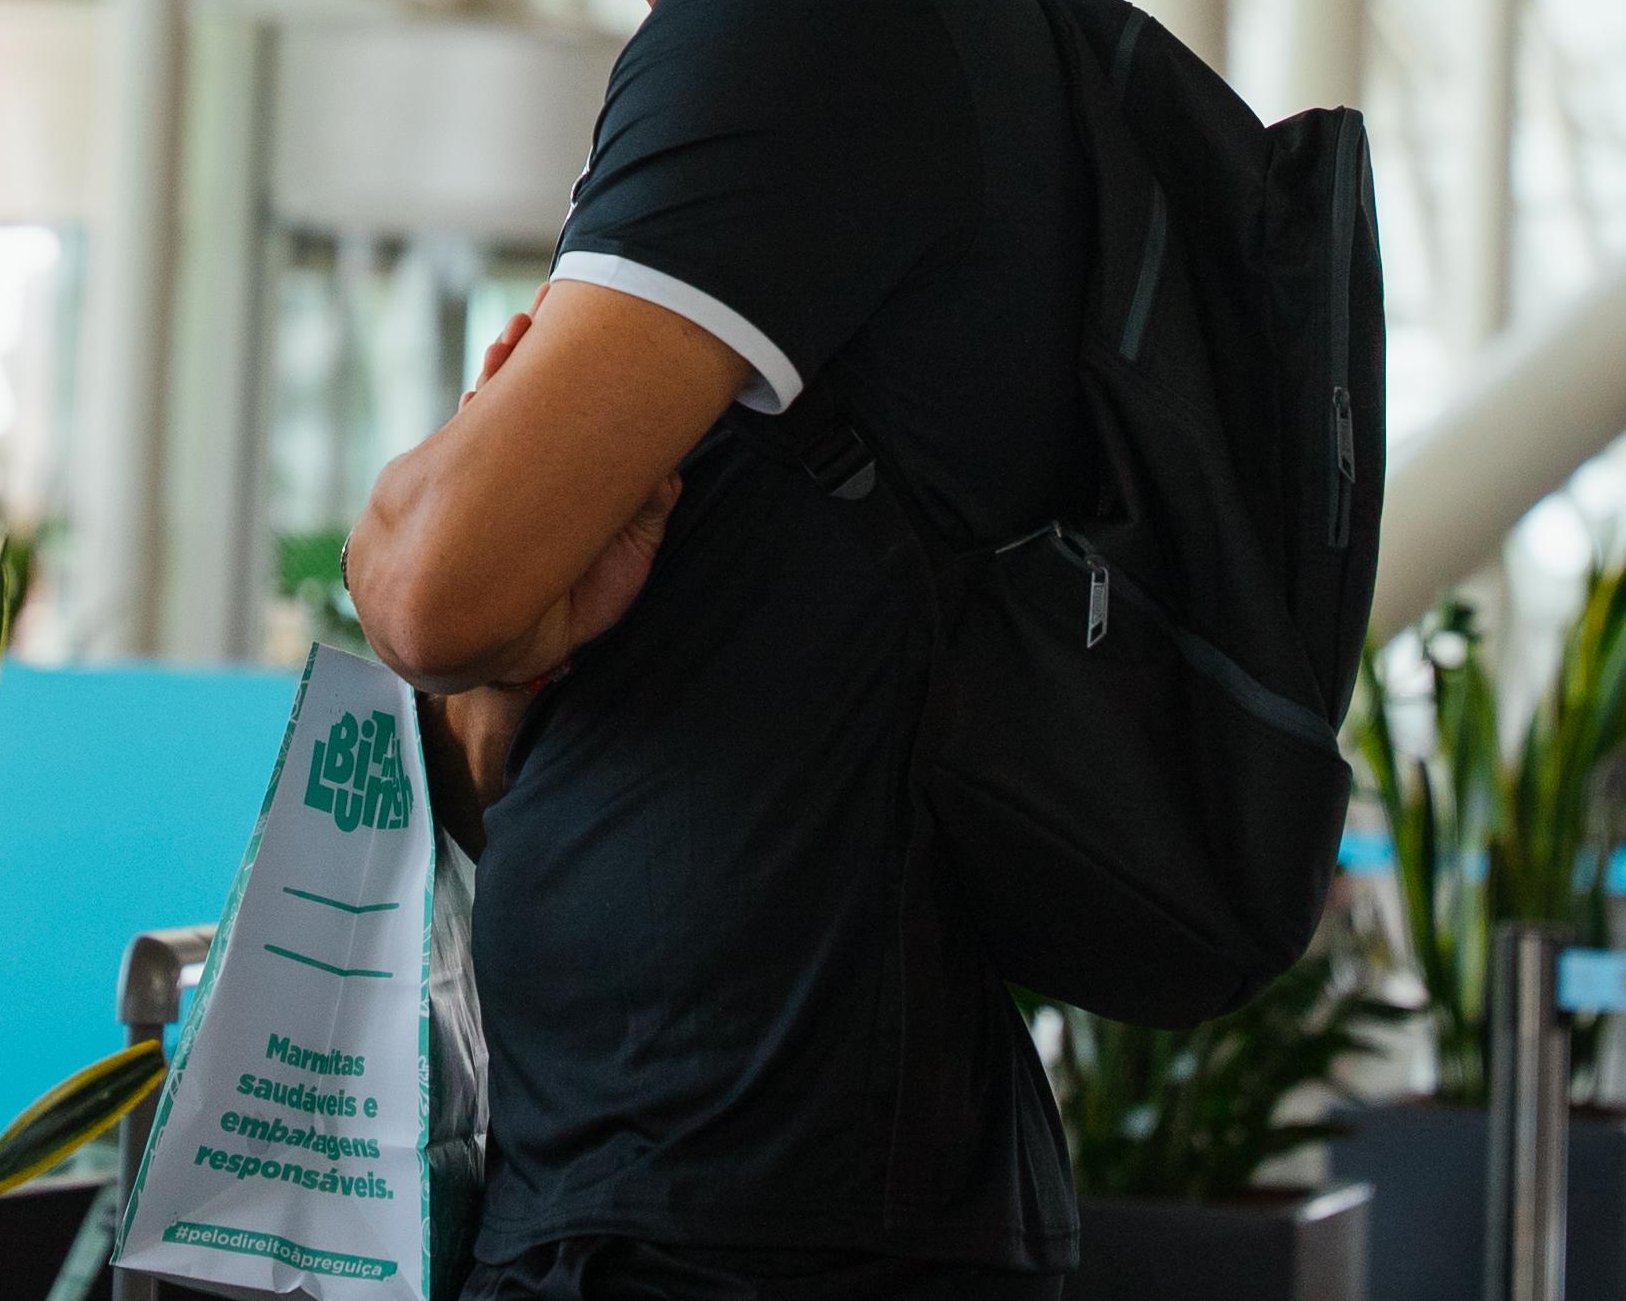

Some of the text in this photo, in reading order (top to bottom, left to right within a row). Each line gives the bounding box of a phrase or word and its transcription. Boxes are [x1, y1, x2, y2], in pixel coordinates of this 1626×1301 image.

[265, 1032, 366, 1077] Marmitas
[236, 1073, 379, 1119] saudáveis e
[220, 1110, 381, 1161] embalagens
[193, 1144, 394, 1200] responsáveis.
[175, 1225, 383, 1277] #pelodireitoàpreguiça
